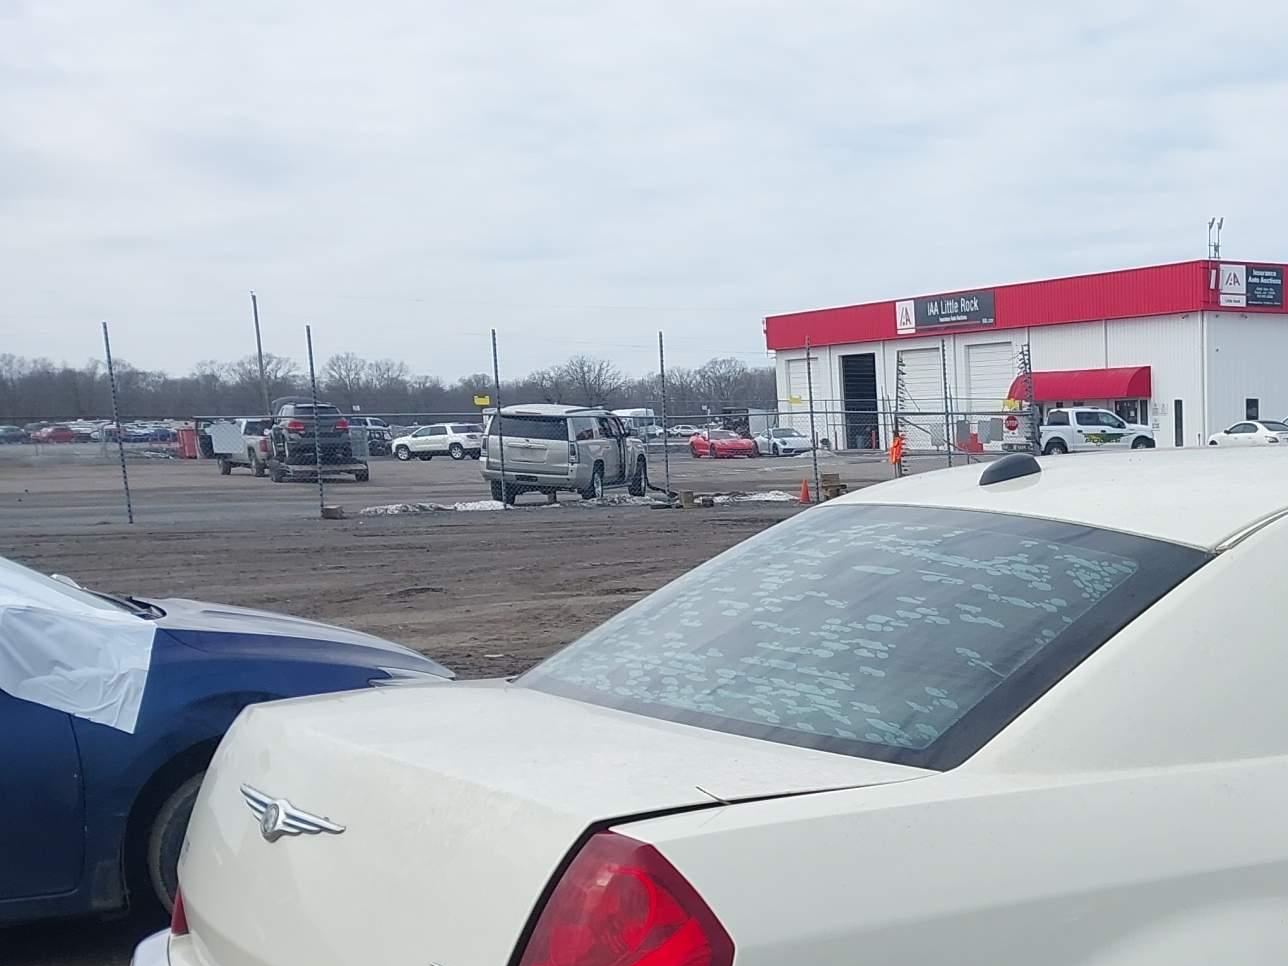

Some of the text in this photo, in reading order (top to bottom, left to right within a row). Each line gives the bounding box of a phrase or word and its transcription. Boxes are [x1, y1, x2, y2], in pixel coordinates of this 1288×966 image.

[927, 296, 979, 316] IAA Little Rock
